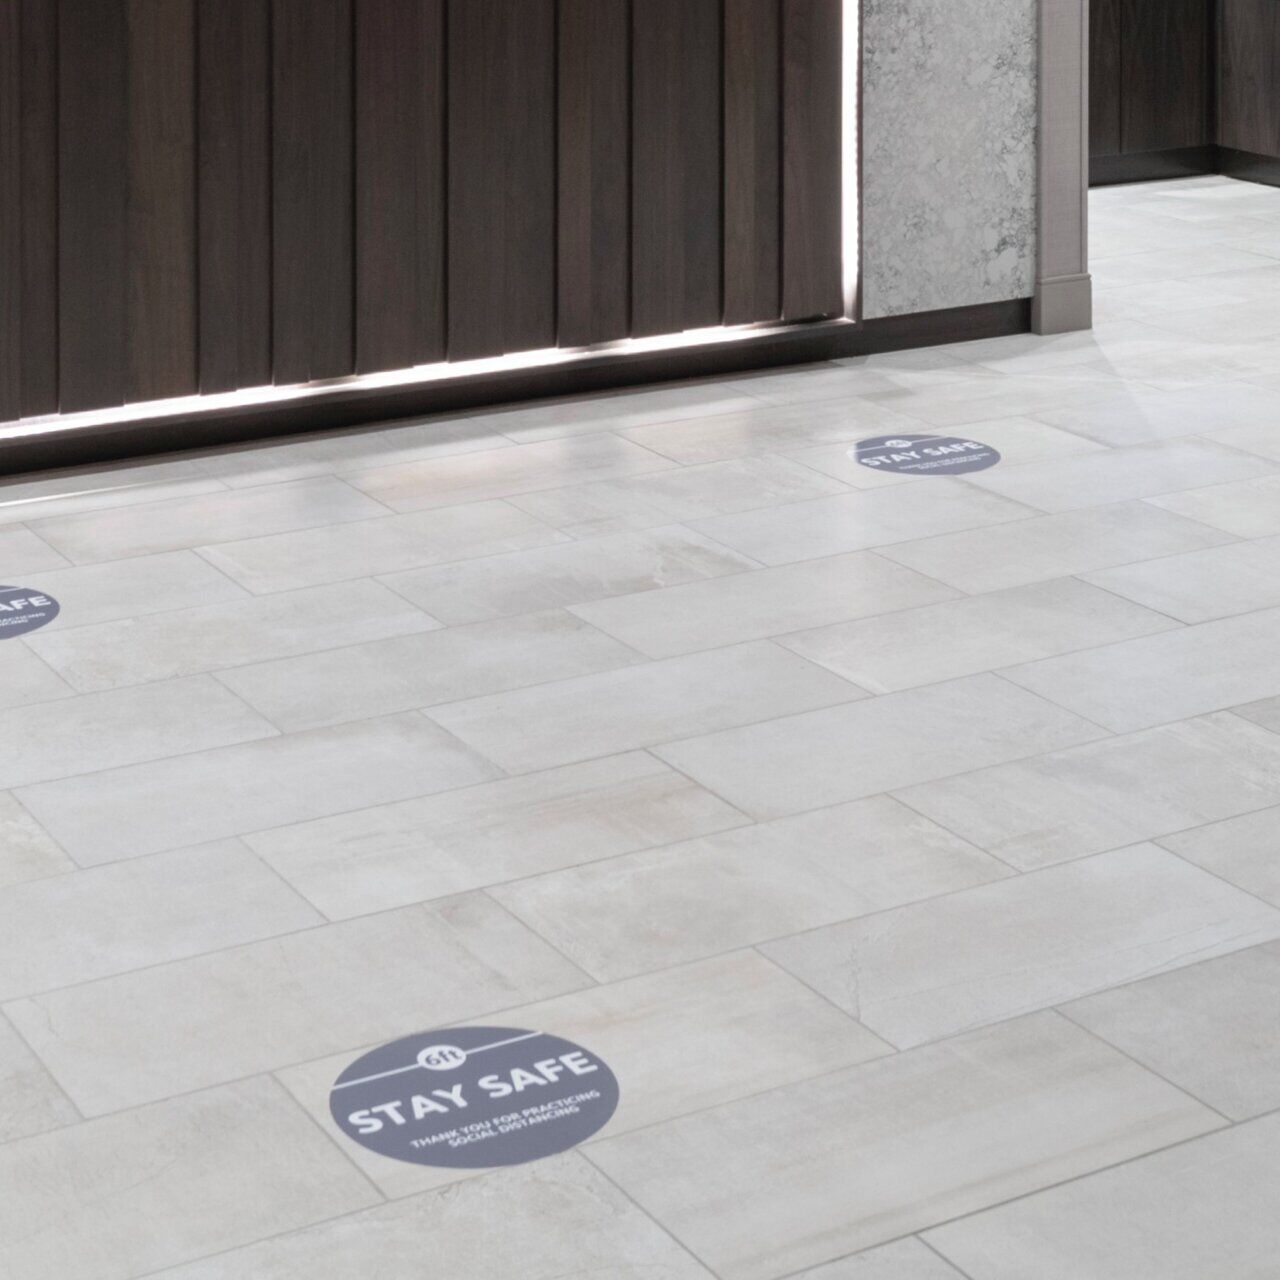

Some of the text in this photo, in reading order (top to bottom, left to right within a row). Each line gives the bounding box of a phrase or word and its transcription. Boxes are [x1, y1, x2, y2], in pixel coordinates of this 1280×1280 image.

[860, 450, 921, 466] STAY
[923, 441, 984, 456] SAFE
[424, 1049, 462, 1067] 6ft
[347, 1050, 599, 1134] STAY SAFE
[409, 1089, 601, 1149] THANK YOU FOR PRACTICING
[448, 1105, 580, 1148] SOCIAL DISTANCING
